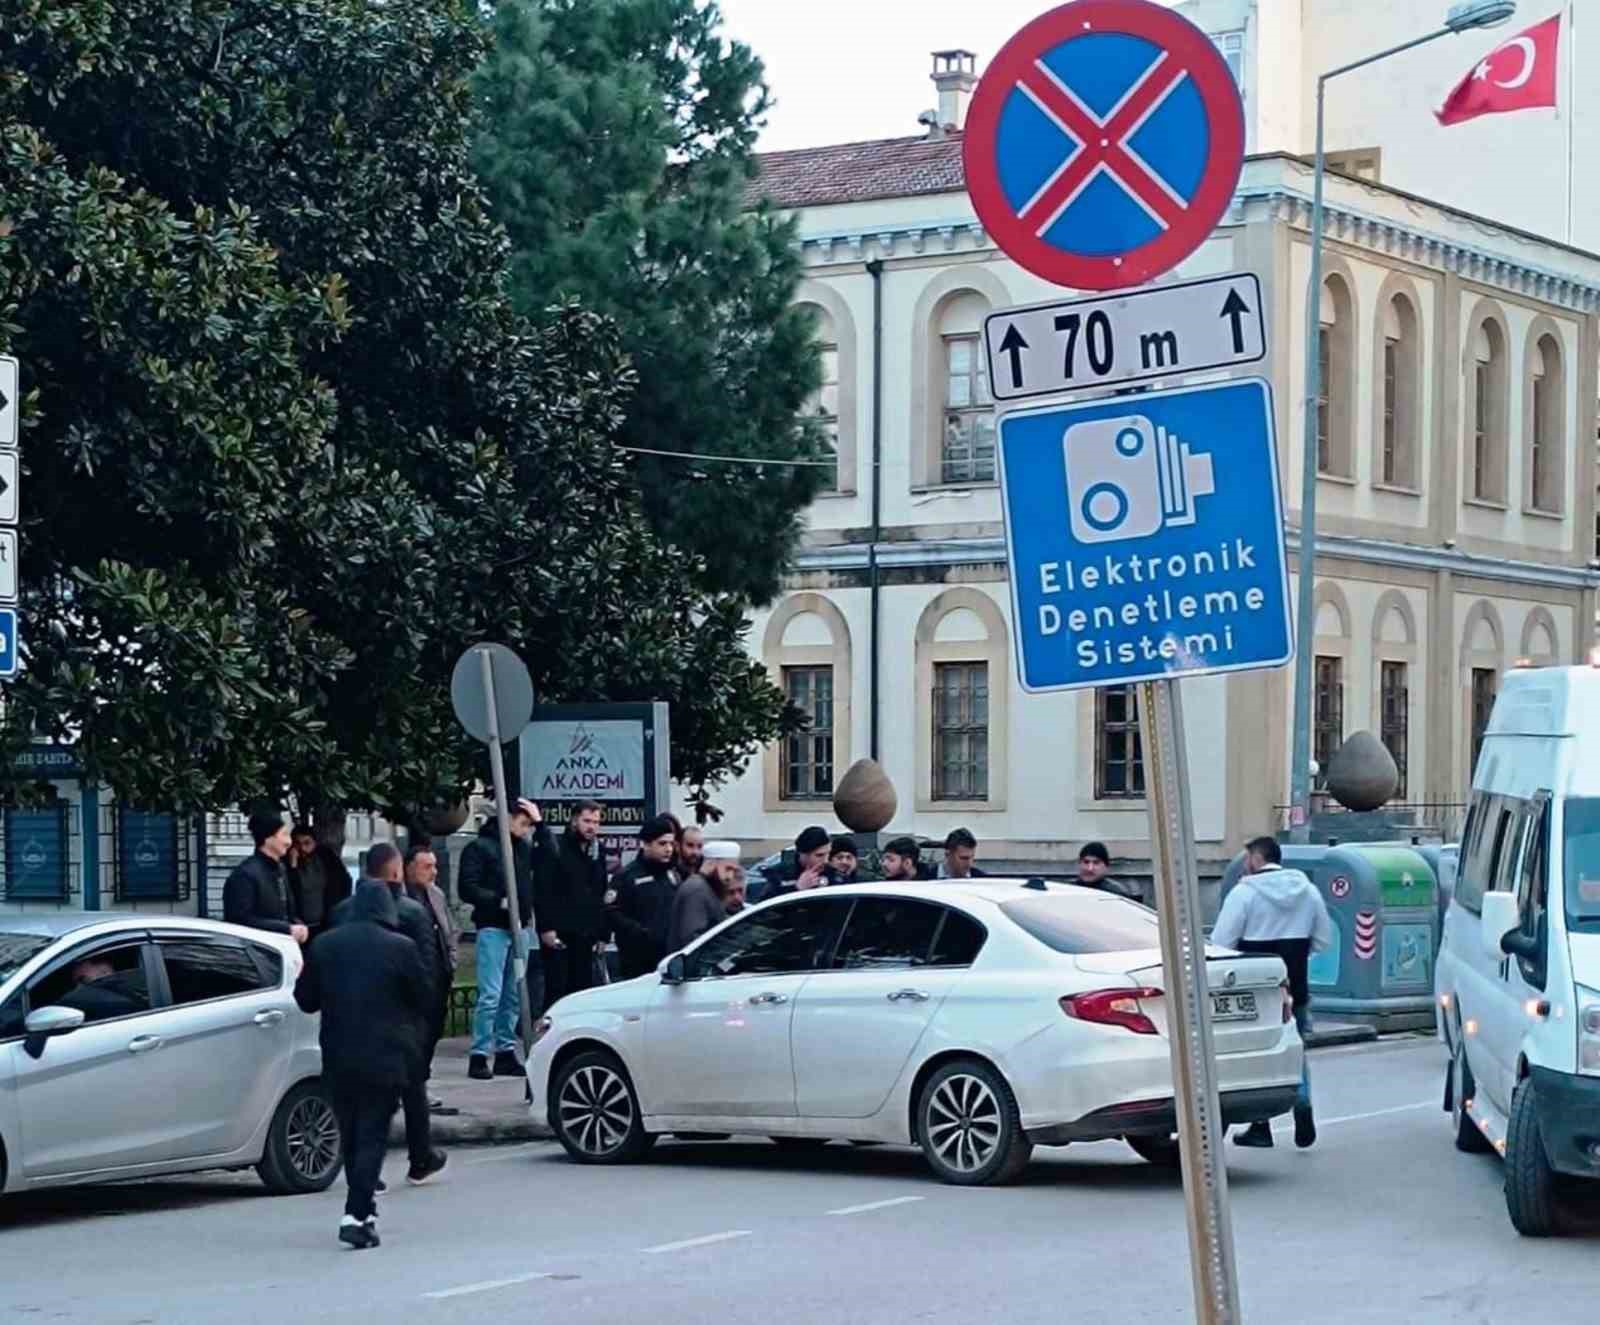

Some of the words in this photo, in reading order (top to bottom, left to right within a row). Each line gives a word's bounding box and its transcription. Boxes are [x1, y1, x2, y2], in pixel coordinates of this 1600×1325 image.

[1054, 310, 1114, 379] 70
[1140, 330, 1179, 369] m
[1039, 538, 1257, 594] Elektronik
[1038, 586, 1265, 636] Denetleme
[1077, 625, 1234, 668] Sistemi
[543, 770, 624, 789] AKADEMİ
[556, 756, 608, 769] ANKA
